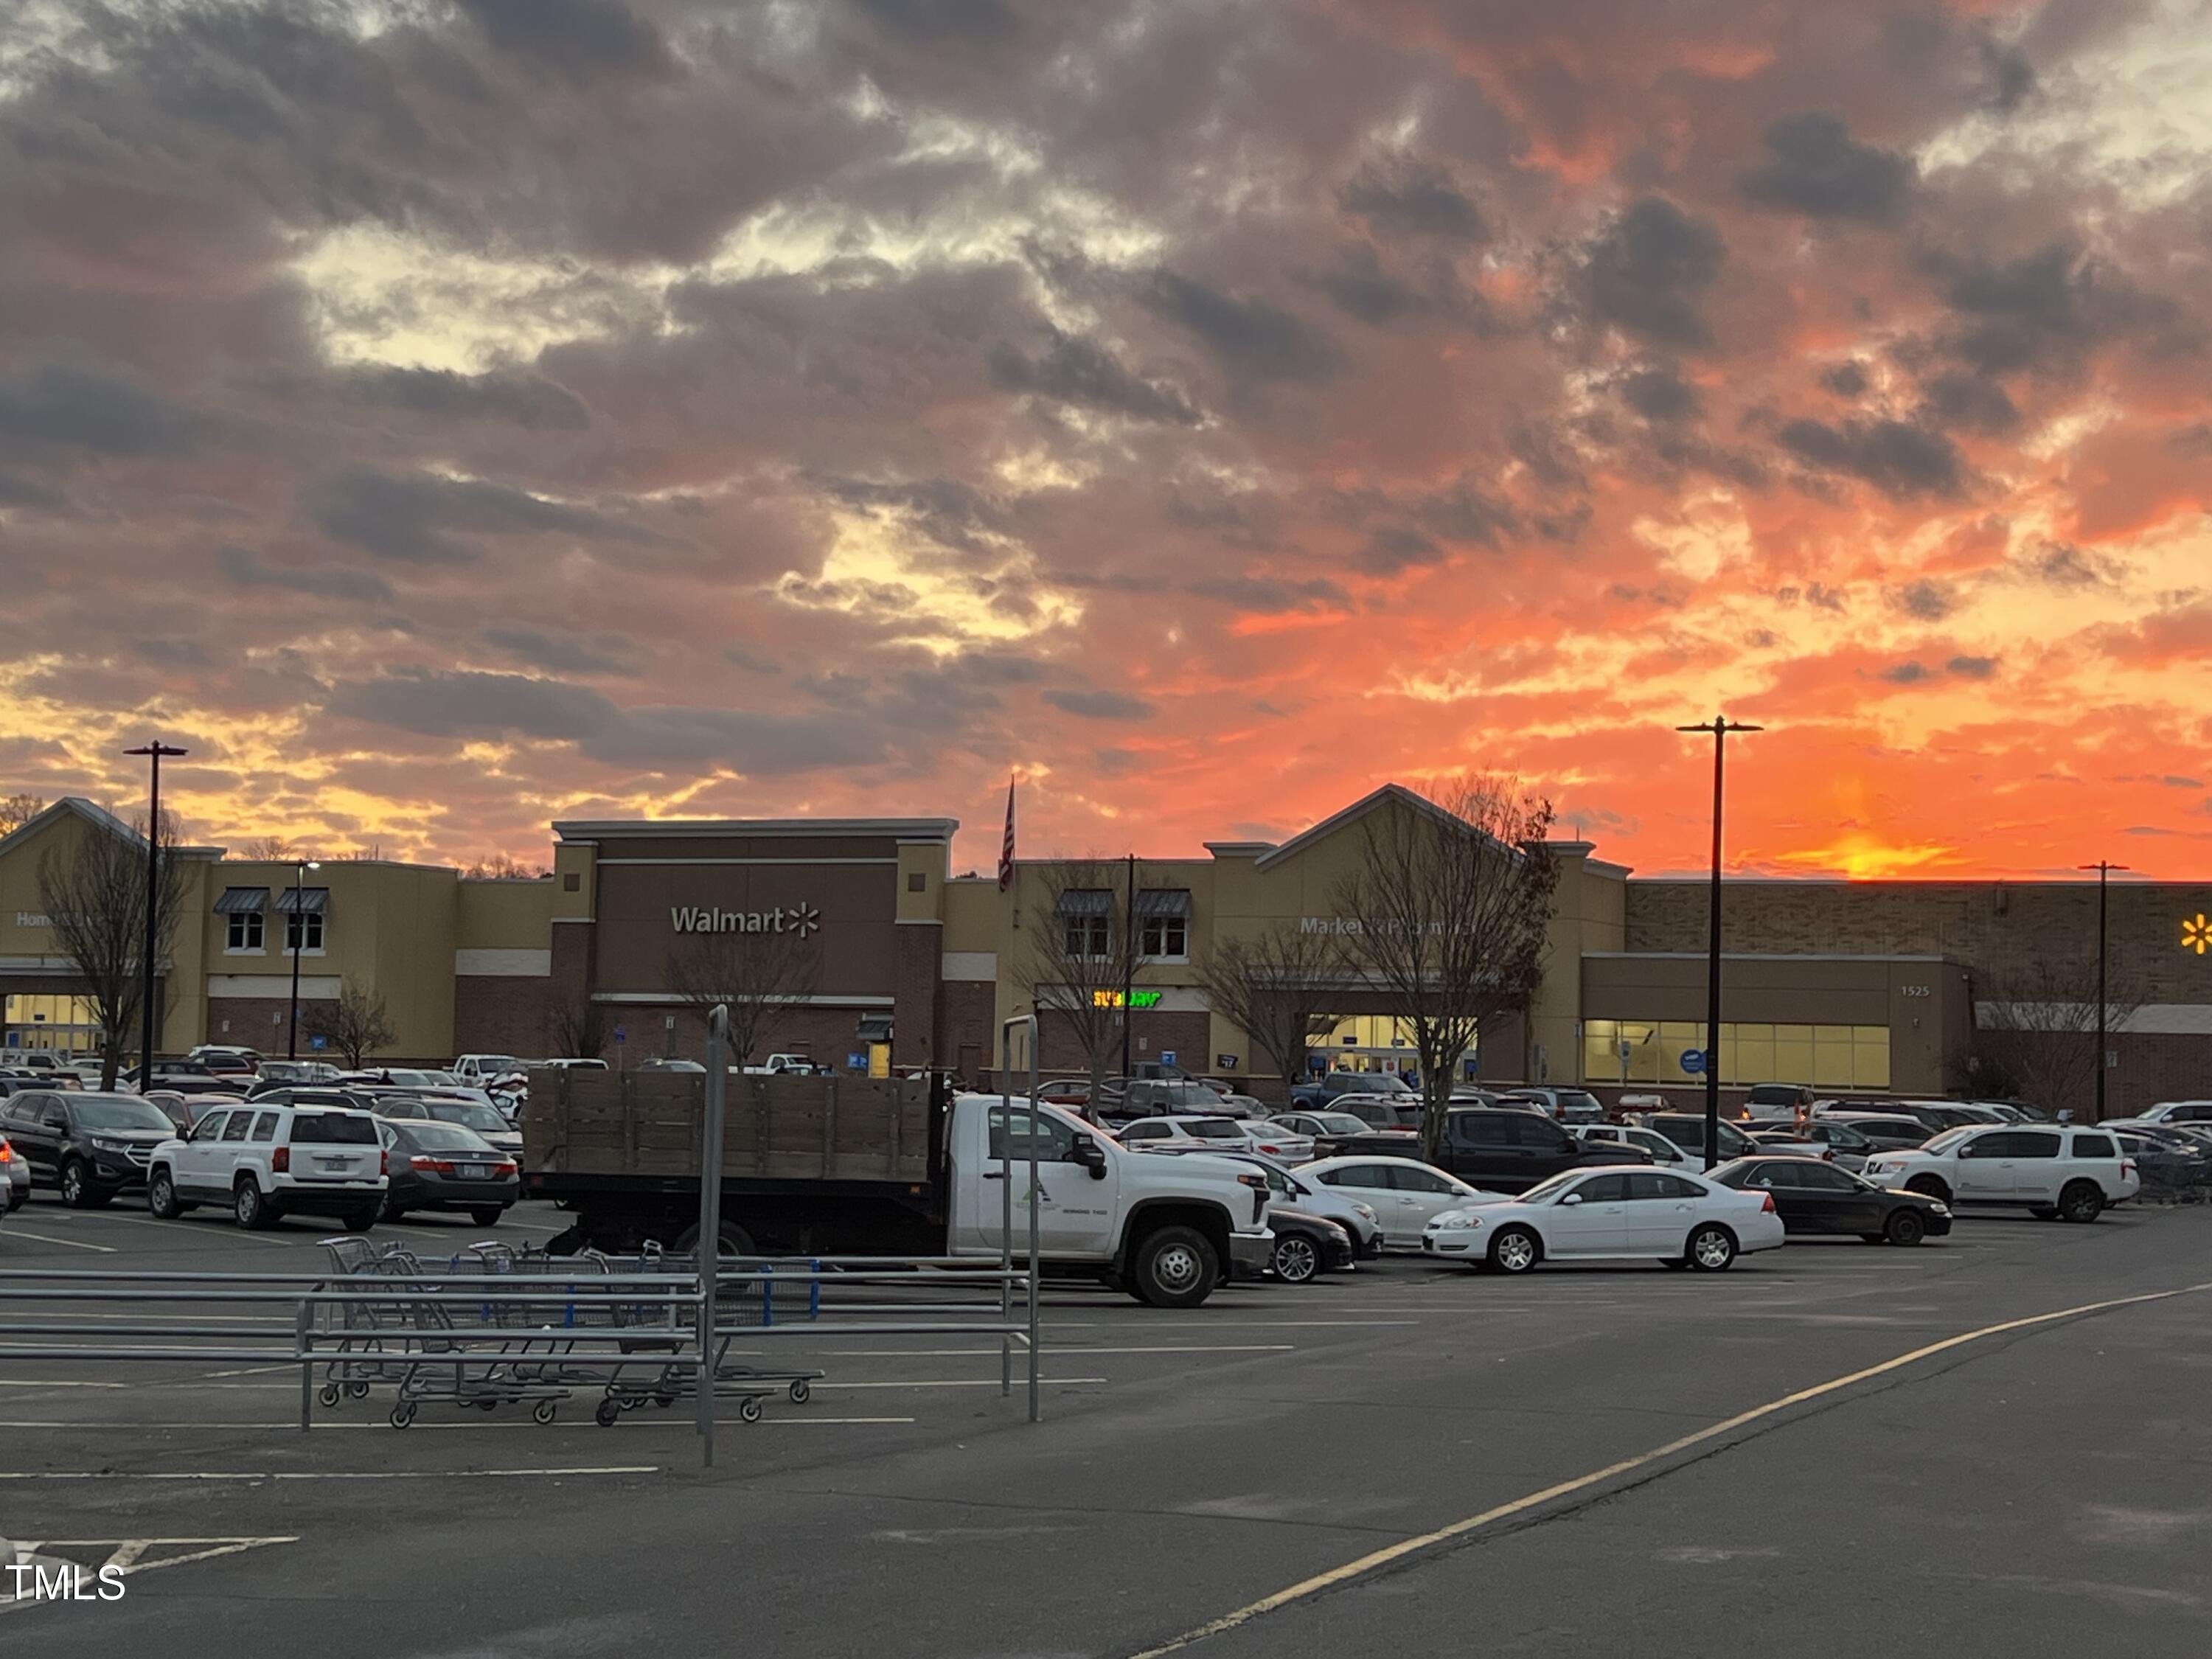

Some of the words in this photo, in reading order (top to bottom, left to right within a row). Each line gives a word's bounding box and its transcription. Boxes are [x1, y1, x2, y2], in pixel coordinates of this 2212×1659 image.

[671, 907, 784, 933] Walmart
[1301, 917, 1364, 935] Market
[1902, 986, 1930, 996] 1525
